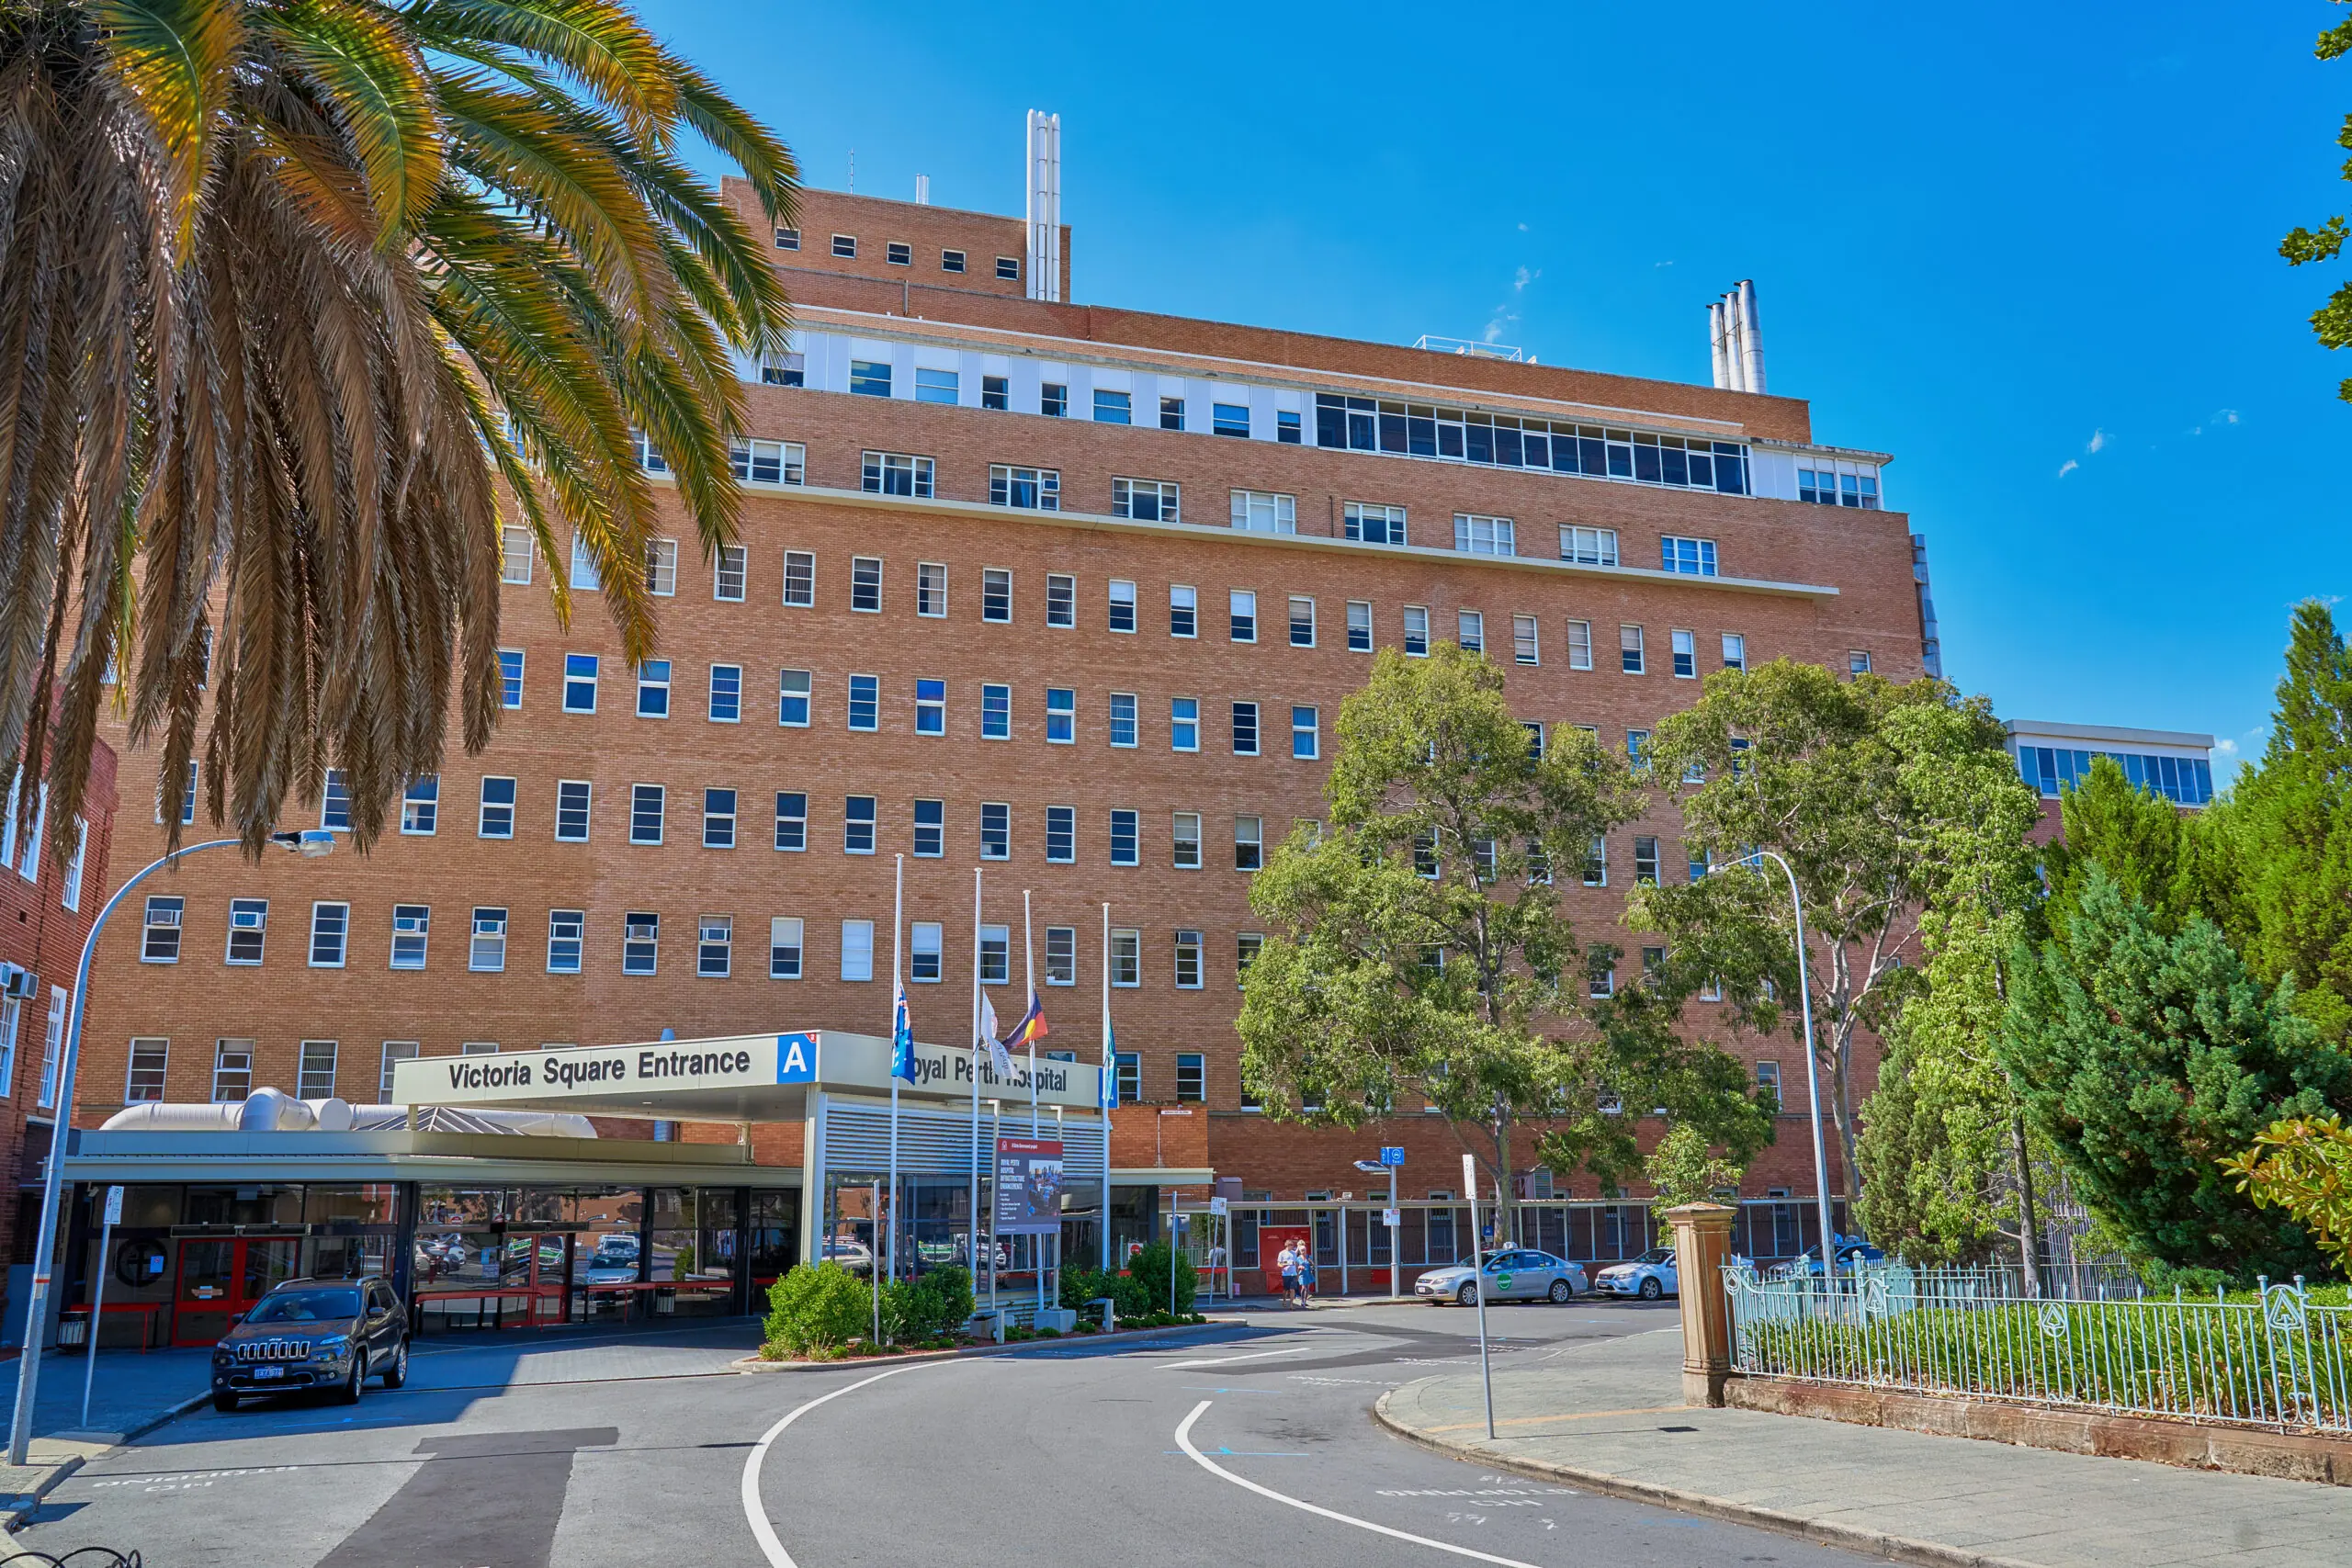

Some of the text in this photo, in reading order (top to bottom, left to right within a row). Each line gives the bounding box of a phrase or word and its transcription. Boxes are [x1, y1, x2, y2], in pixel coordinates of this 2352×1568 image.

[448, 1050, 751, 1089] Victoria Square Entrance
[783, 1041, 808, 1073] A
[914, 1055, 947, 1085] oyal
